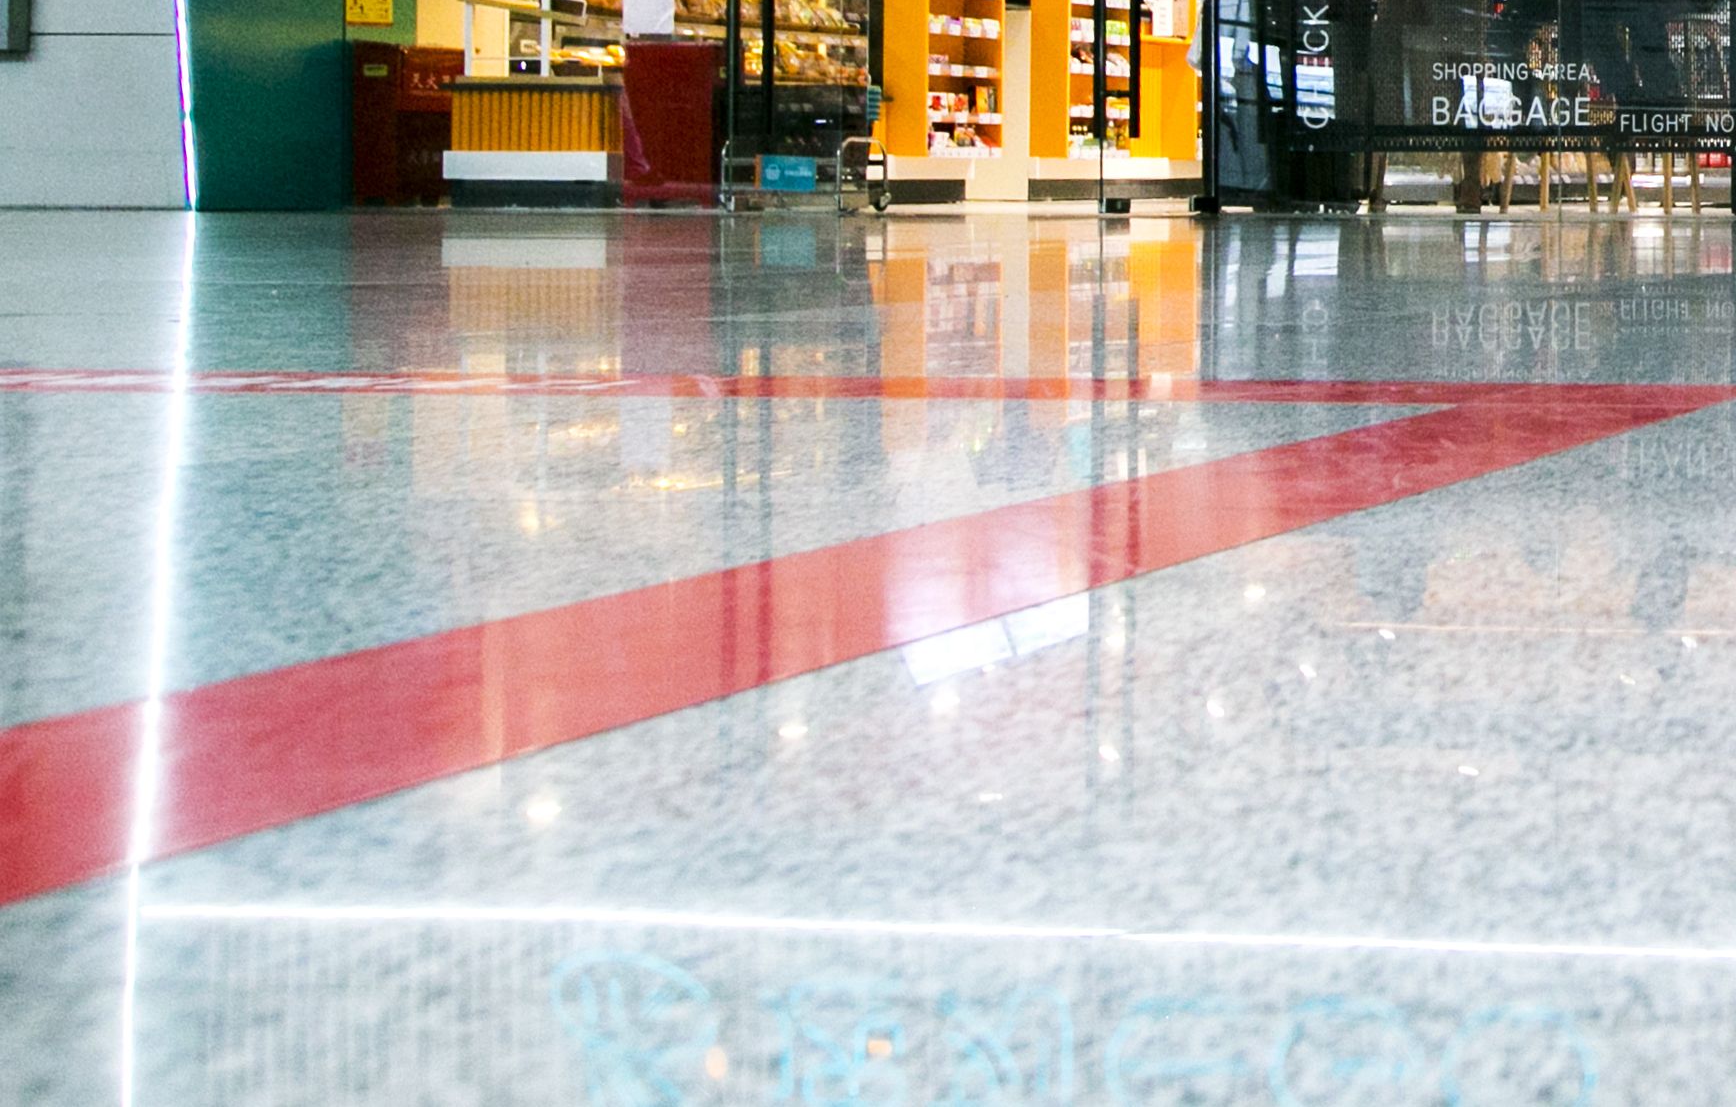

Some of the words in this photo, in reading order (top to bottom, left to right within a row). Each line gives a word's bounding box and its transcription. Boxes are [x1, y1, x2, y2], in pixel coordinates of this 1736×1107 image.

[1303, 4, 1331, 130] CCK
[1432, 62, 1529, 81] SHOPPING
[1541, 62, 1591, 81] AREA
[1432, 95, 1592, 127] BAGGAGE
[1620, 113, 1693, 133] FLIGHT
